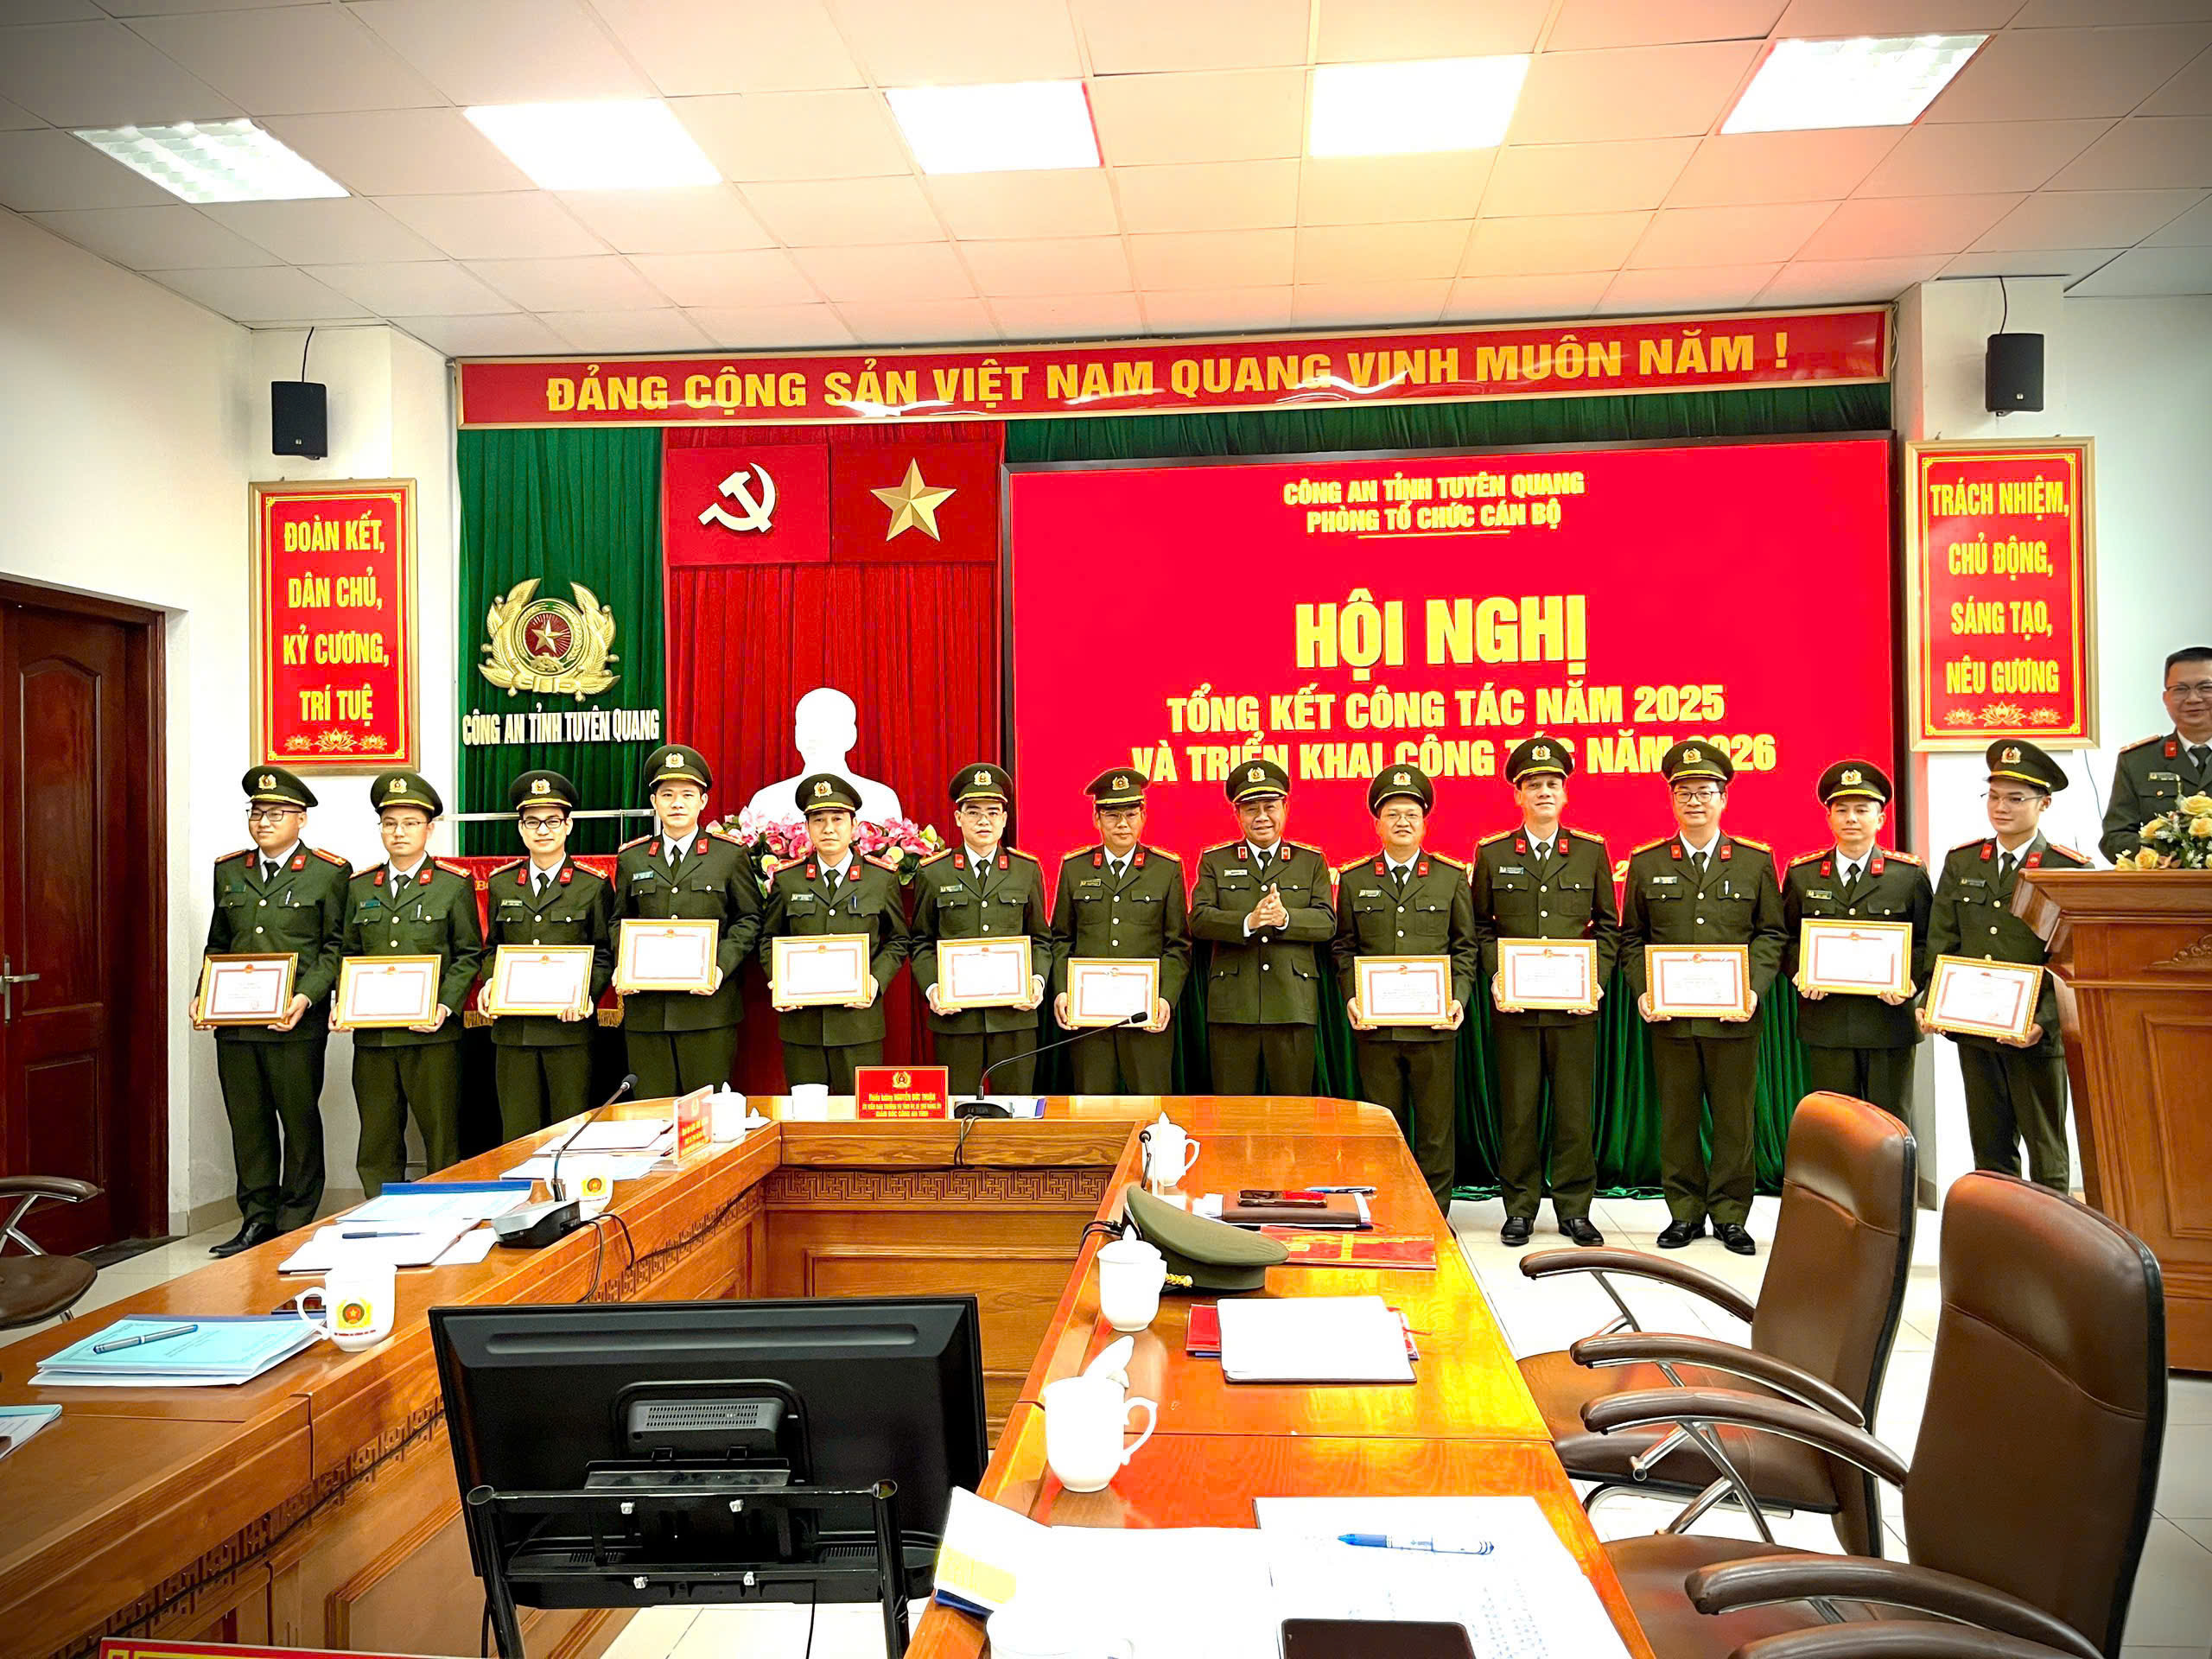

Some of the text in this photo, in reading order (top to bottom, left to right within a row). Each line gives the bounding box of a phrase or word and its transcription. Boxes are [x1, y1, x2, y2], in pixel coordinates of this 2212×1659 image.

[546, 327, 1789, 416] ĐẢNG CỘNG SẢN VIỆT NAM QUANG VINH MUÔN NĂM !
[1284, 472, 1585, 505] CÔNG AN TỈNH TUYÊN QUANG
[1930, 474, 2069, 521] TRÁCH NHIỆM,
[284, 510, 385, 554] ĐOÀN KẾT,
[1307, 498, 1561, 533] PHÒNG TỔ CHỨC CÁN BỘ
[1948, 531, 2054, 582] CHỦ ĐỘNG,
[289, 567, 383, 612] DÂN CHỦ,
[1295, 588, 1586, 681] HỘI NGHỊ
[1950, 595, 2053, 641] SÁNG TẠO,
[283, 624, 390, 668] KỶ CƯƠNG,
[1946, 654, 2060, 695] NÊU GƯƠNG
[299, 683, 373, 727] TRÍ TUỆ
[461, 701, 660, 747] CÔNG AN TỈNH TUYÊN QUANG
[1166, 683, 1725, 734] TỔNG KẾT CÔNG TÁC NĂM 2025
[1131, 740, 1178, 781] VÀ
[1299, 742, 1382, 779] KHAI
[1395, 734, 1496, 778] CÔNG
[1586, 728, 1674, 774] NĂM
